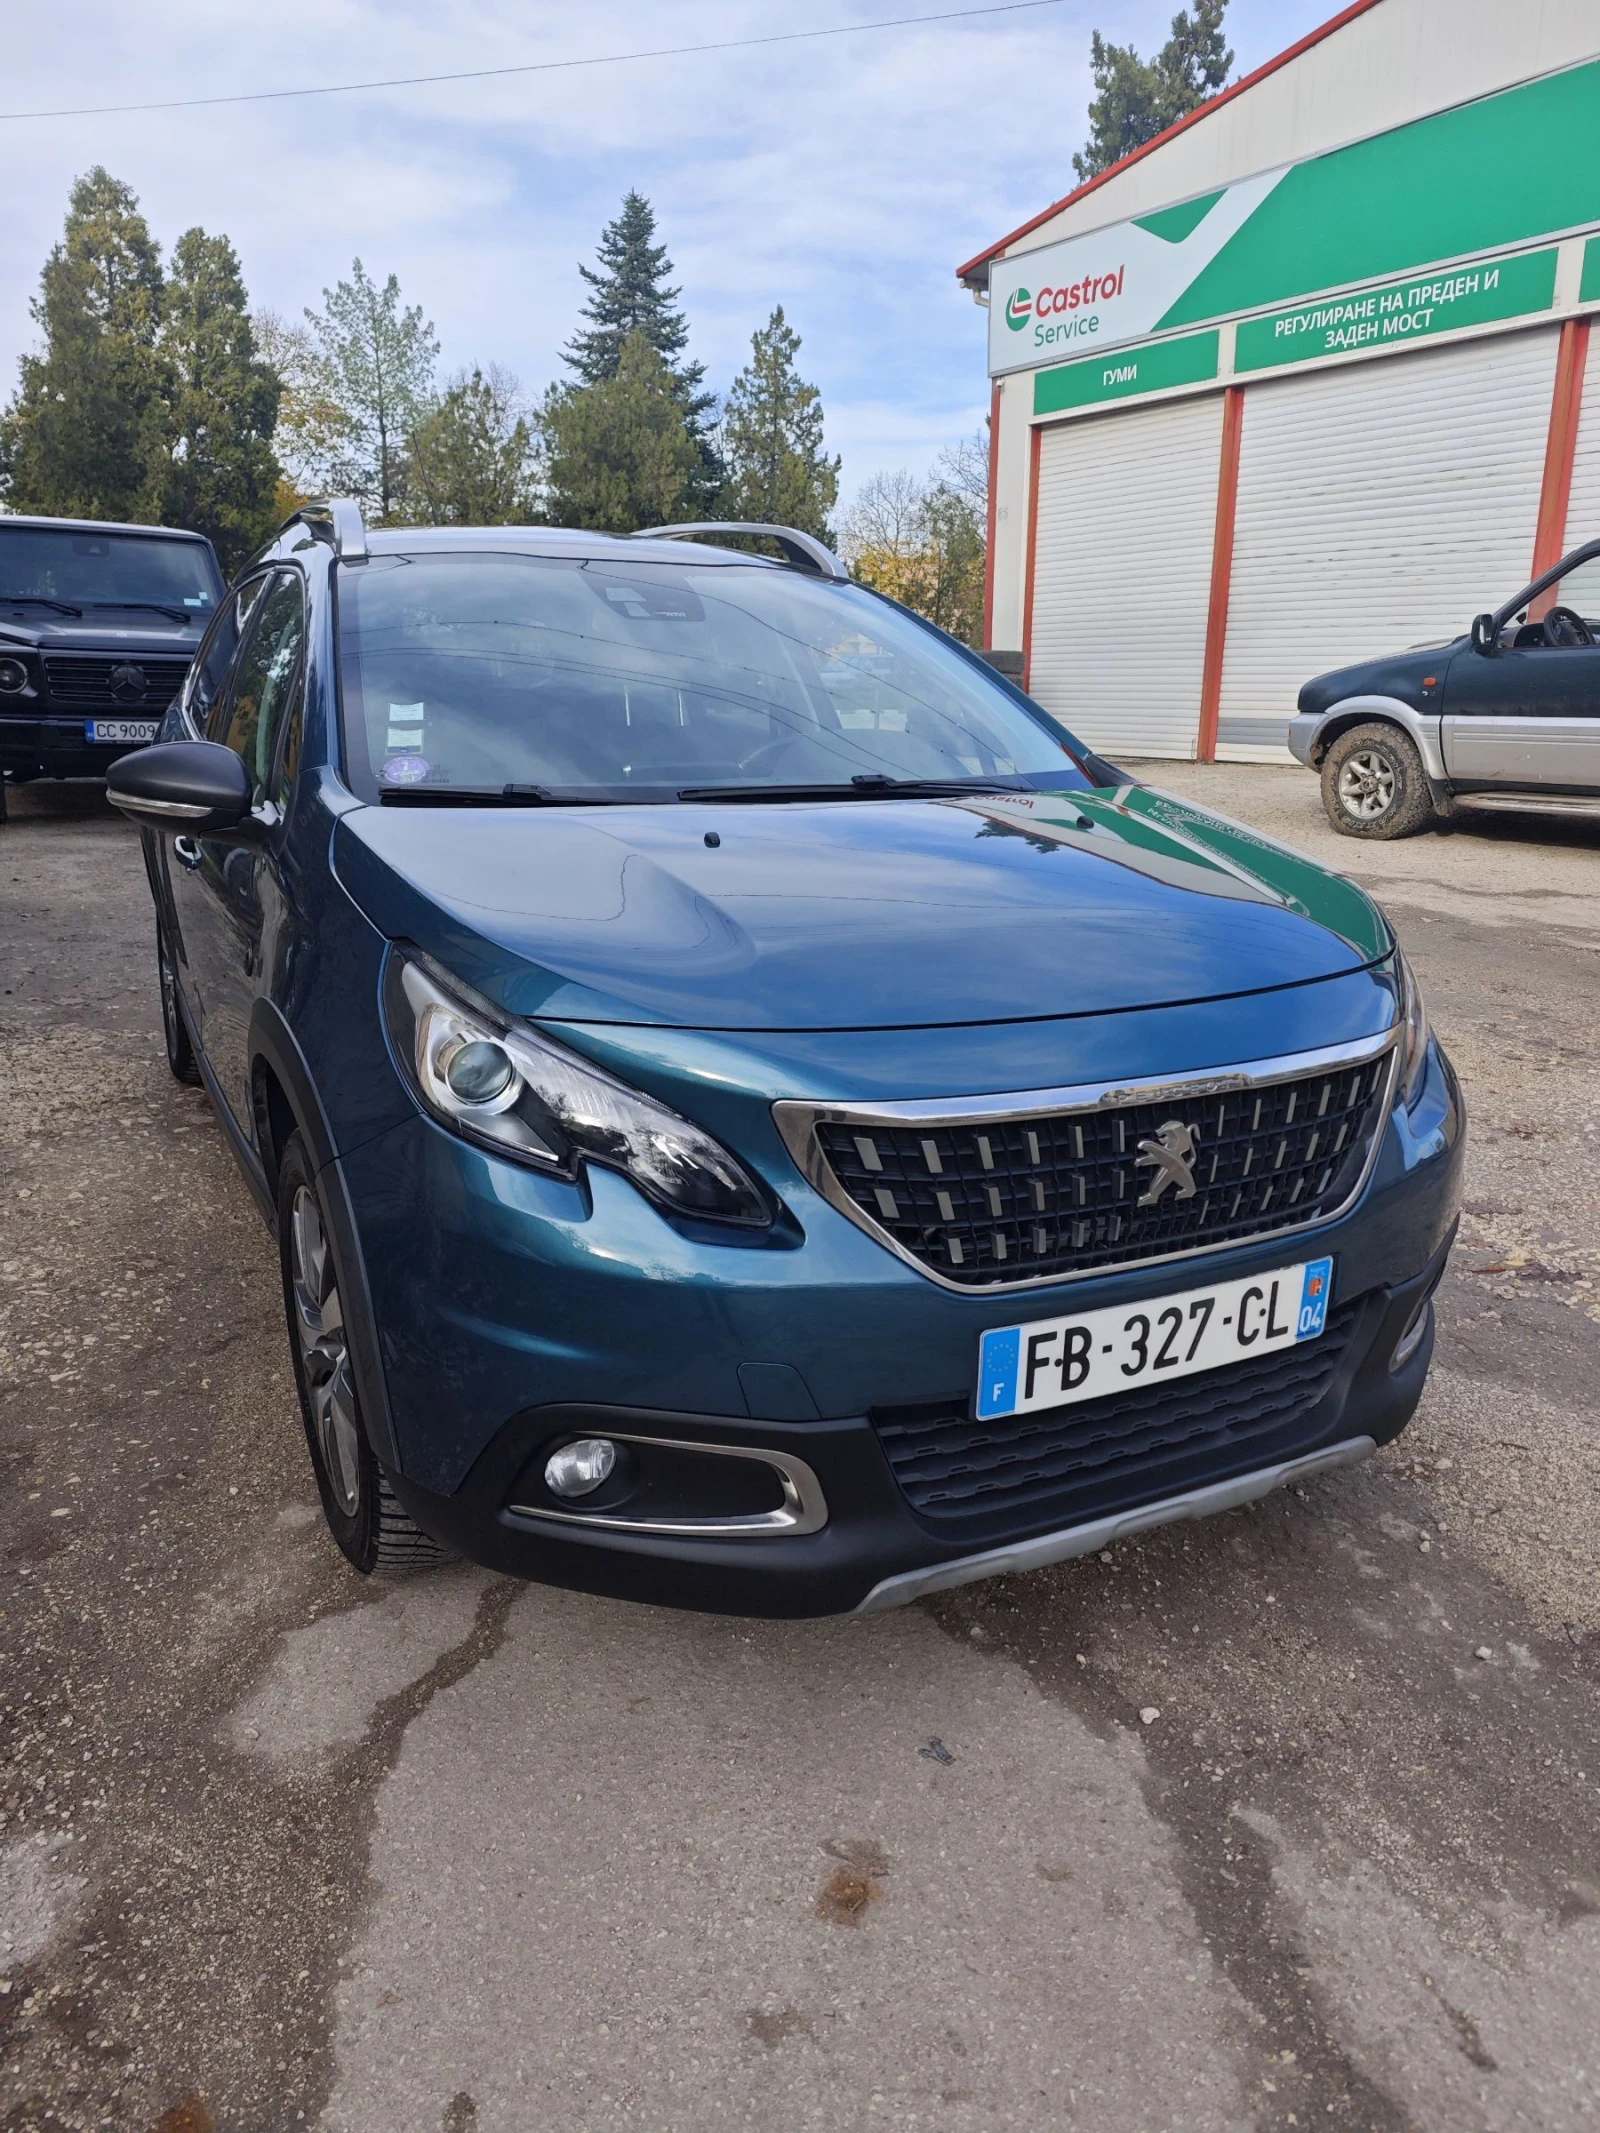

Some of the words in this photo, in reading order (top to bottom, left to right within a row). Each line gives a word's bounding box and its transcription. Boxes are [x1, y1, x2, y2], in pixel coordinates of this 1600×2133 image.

[1036, 264, 1125, 318] Castrol
[1275, 298, 1376, 337] РЕГУЛИРАНЕ
[1379, 292, 1404, 314] НА
[1408, 273, 1479, 307] ПРЕДЕН
[1483, 269, 1500, 289] И
[1034, 314, 1099, 347] Service
[1324, 321, 1379, 348] ЗАДЕН
[1383, 308, 1434, 336] МОСТ
[1103, 364, 1138, 386] ГУМИ
[96, 724, 117, 738] CC
[119, 724, 155, 738] 9009
[1118, 1079, 1236, 1104] PEUGEOT
[1300, 1302, 1322, 1332] 04
[993, 1382, 1004, 1402] F
